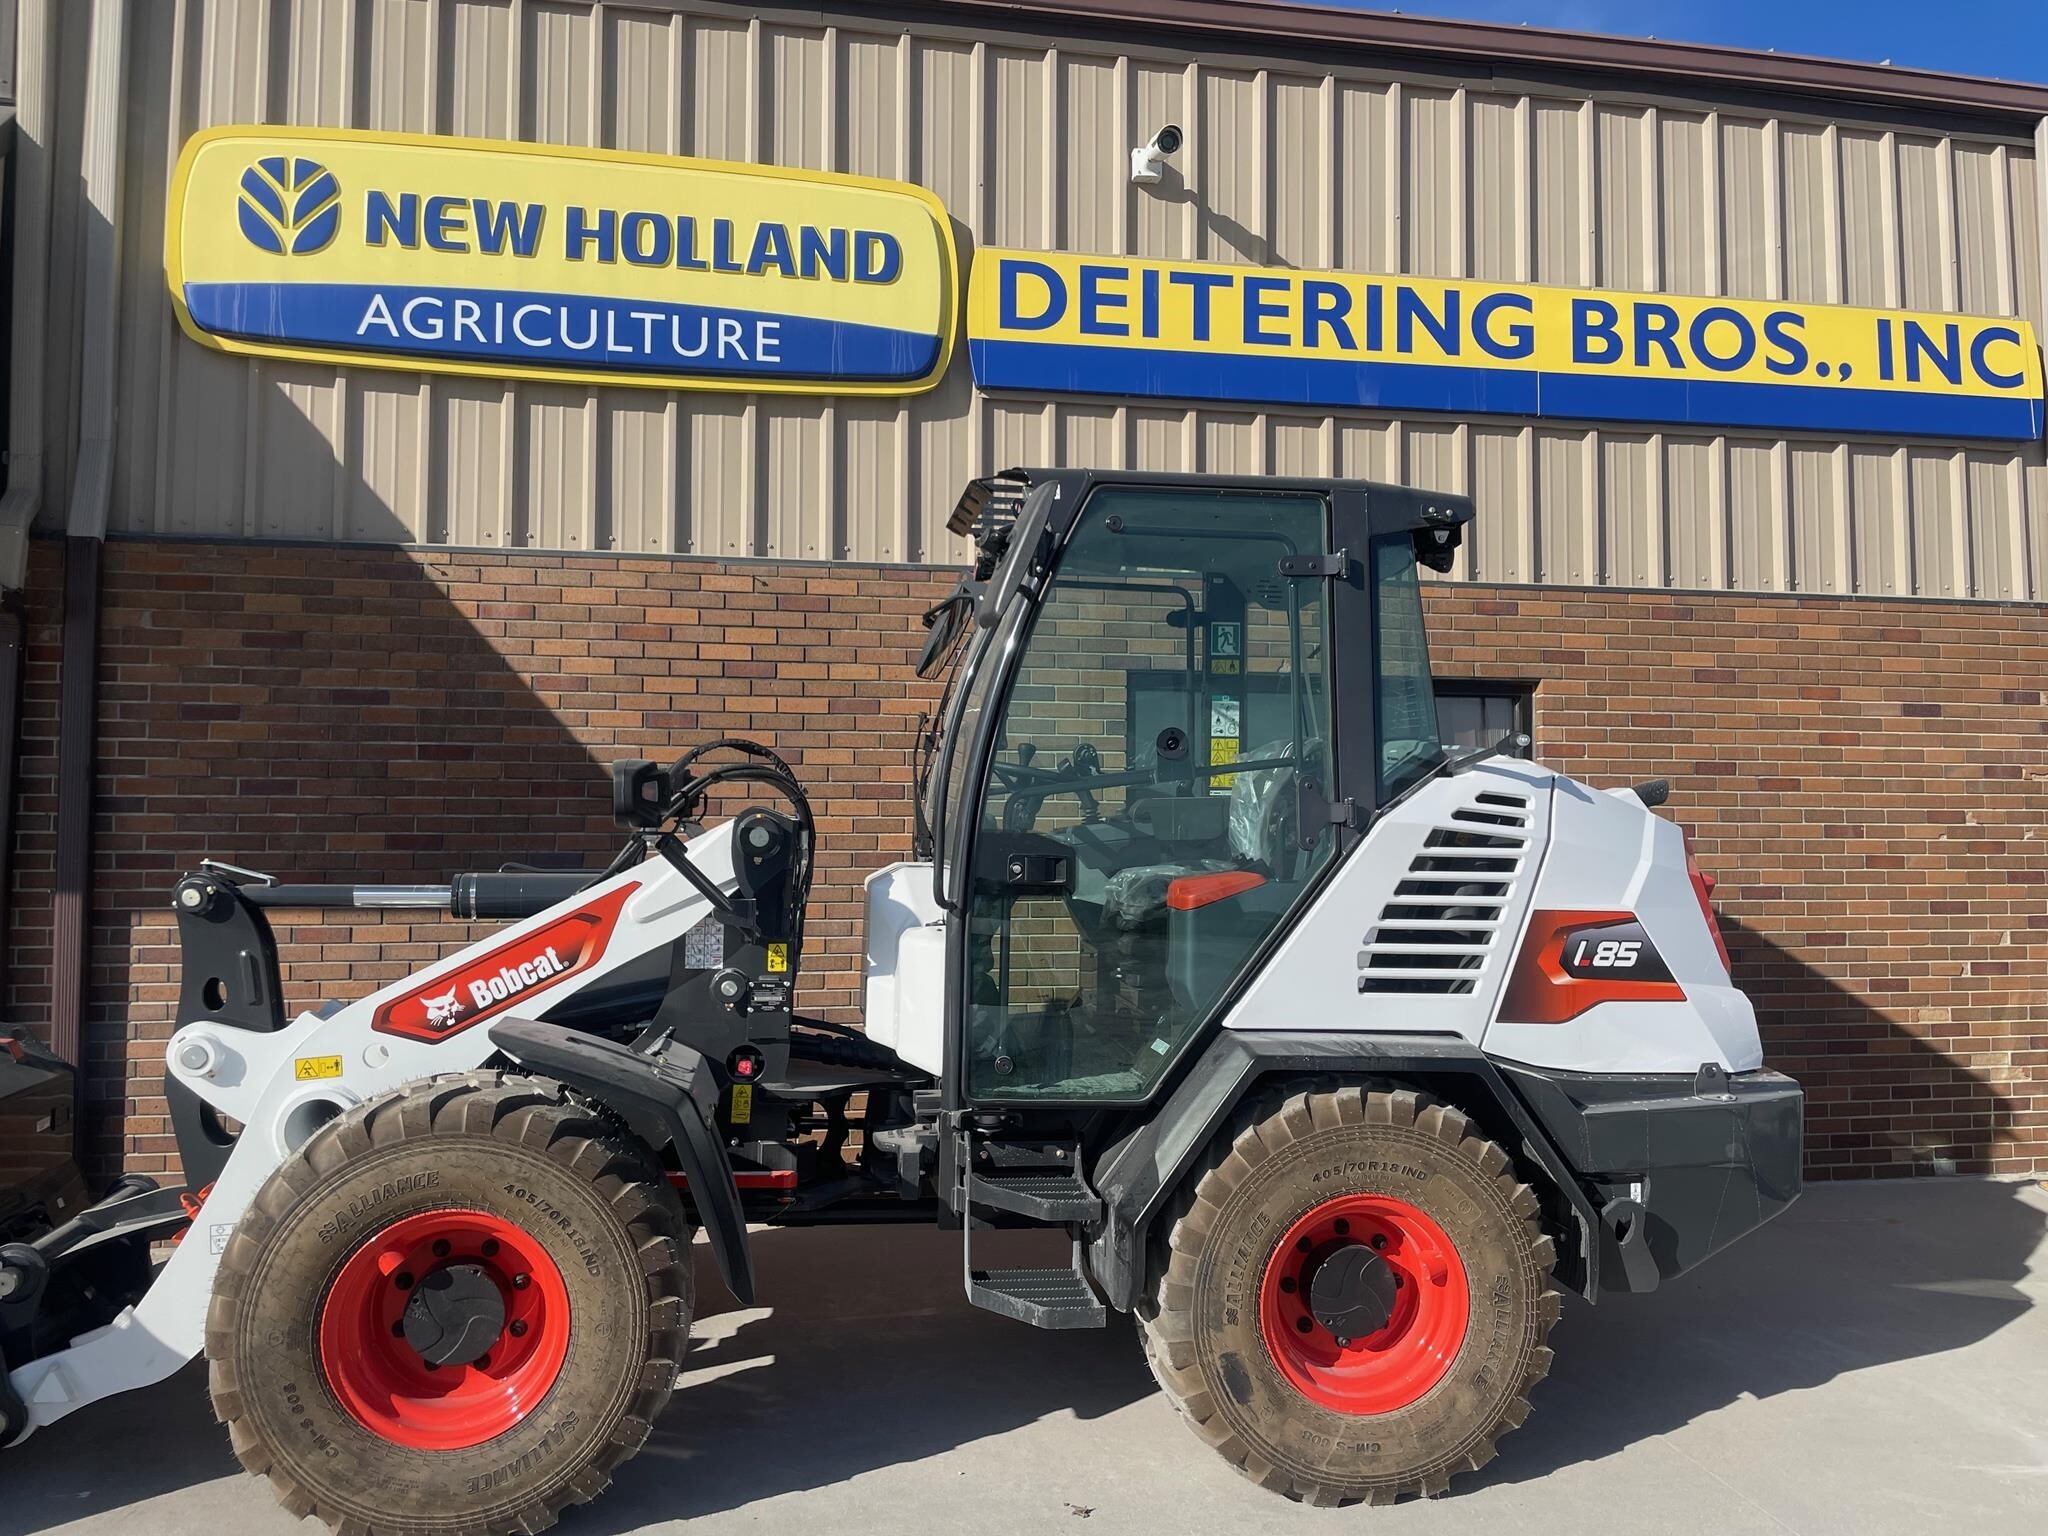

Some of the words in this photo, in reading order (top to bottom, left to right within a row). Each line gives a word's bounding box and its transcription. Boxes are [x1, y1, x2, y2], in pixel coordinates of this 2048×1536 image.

[365, 189, 545, 258] NEW
[564, 205, 904, 286] HOLLAND
[356, 293, 781, 363] AGRICULTURE
[999, 259, 1535, 361] DEITERING
[1571, 298, 1853, 383] BROS.,
[1876, 318, 2025, 388] INC
[467, 946, 564, 1009] Bobcat
[334, 1170, 440, 1234] ALLIANCE
[1226, 1211, 1272, 1311] ALLIANCE
[1474, 1290, 1512, 1392] ALLIANCE
[466, 1422, 565, 1495] ALLIANCE
